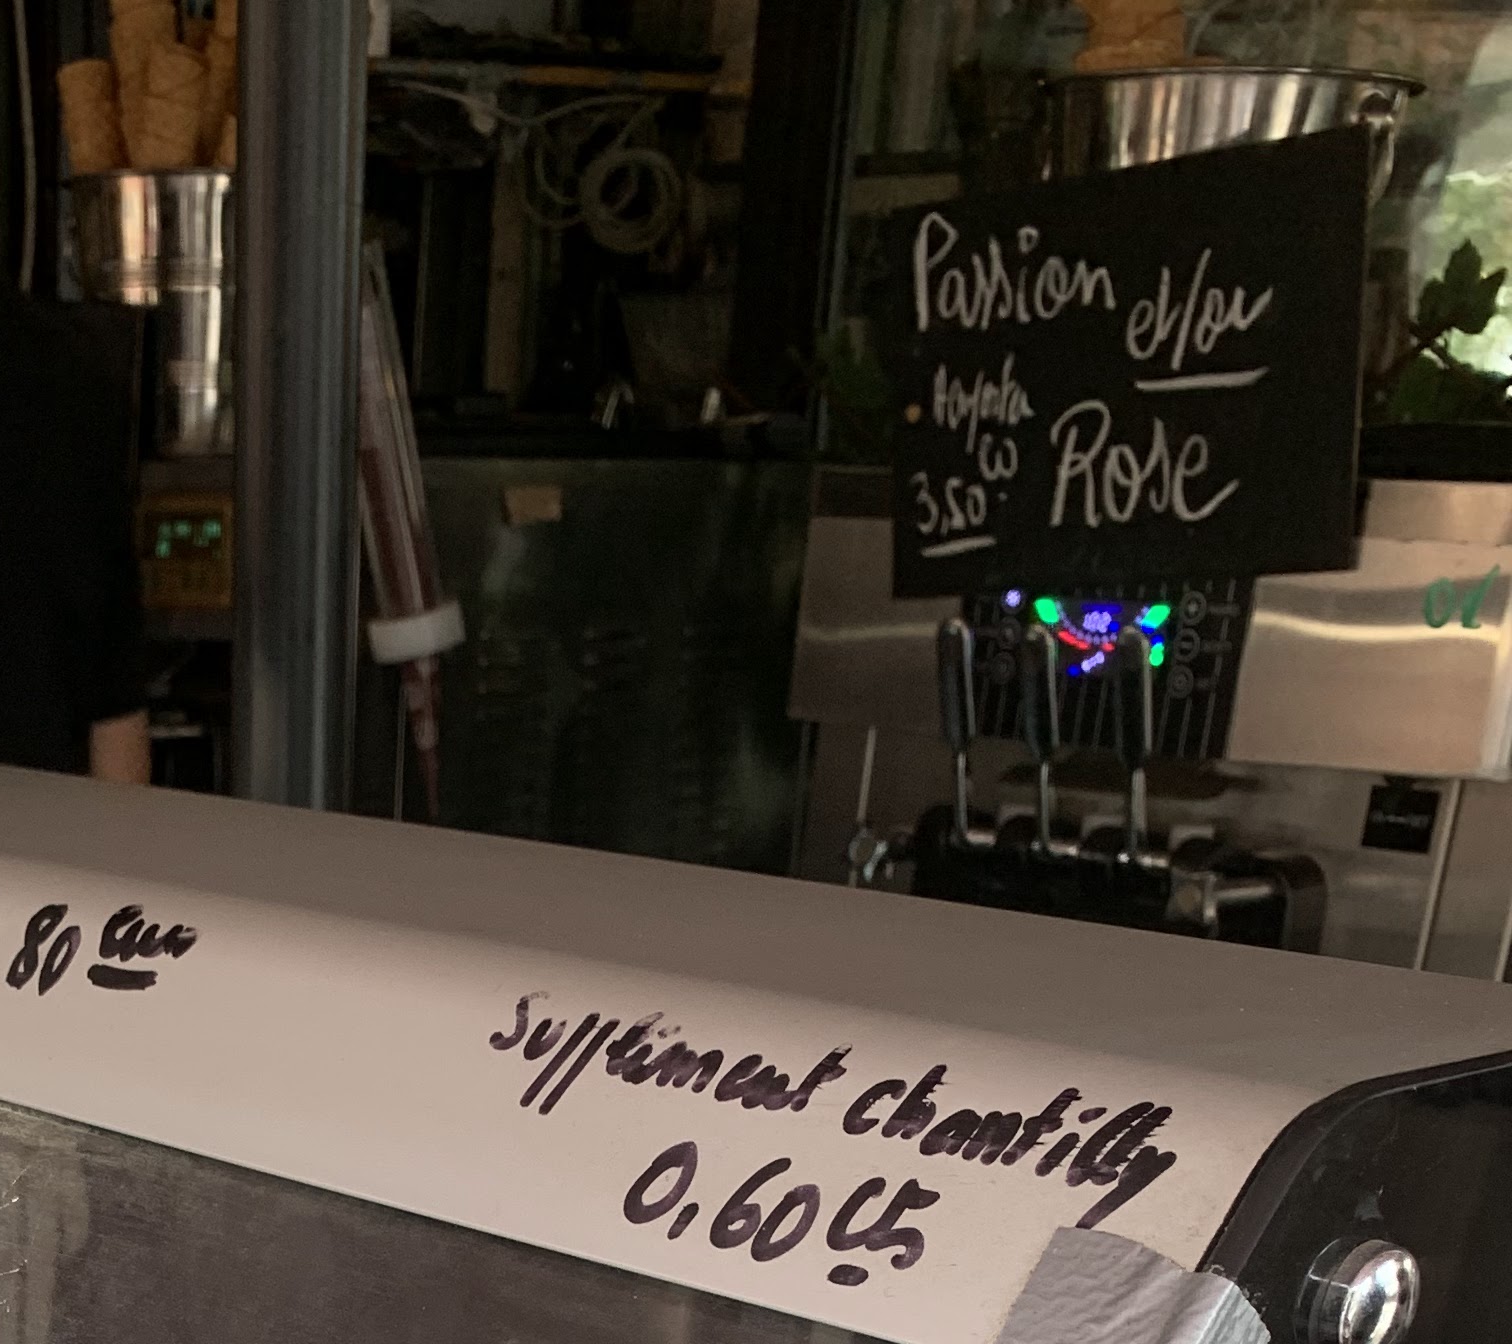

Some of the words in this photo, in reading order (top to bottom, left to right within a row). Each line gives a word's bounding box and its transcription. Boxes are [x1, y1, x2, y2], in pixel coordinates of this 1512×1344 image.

[912, 213, 1116, 331] Passion
[1050, 399, 1240, 527] Rose
[623, 1140, 822, 1263] 0,60
